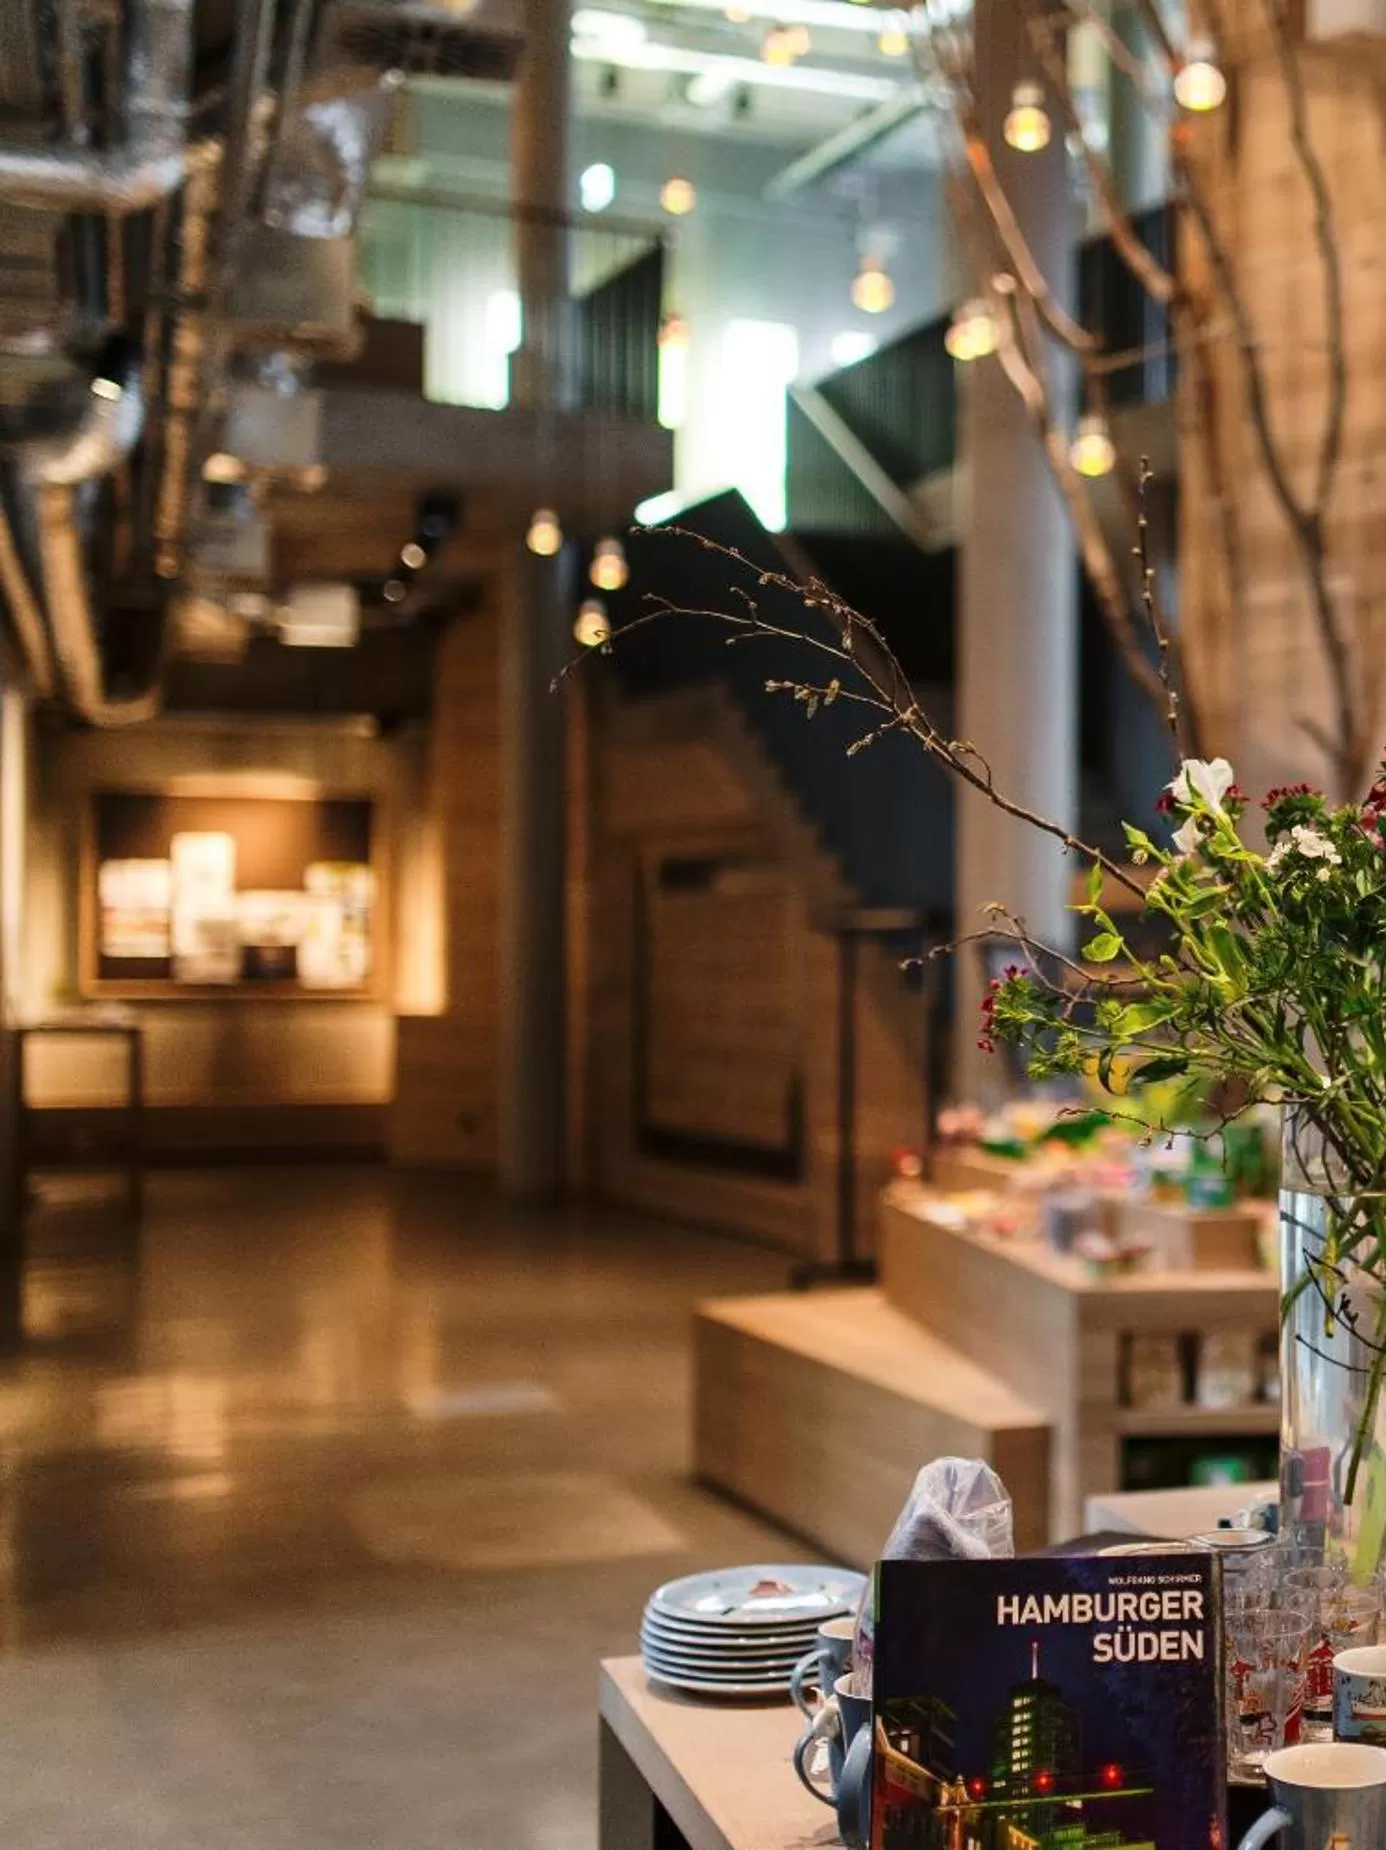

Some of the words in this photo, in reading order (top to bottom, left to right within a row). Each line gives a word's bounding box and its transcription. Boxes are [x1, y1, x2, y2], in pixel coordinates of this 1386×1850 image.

[1108, 1576, 1155, 1585] WOLFGANG
[997, 1590, 1204, 1625] HAMBURGER
[1093, 1626, 1204, 1662] SÜDEN
